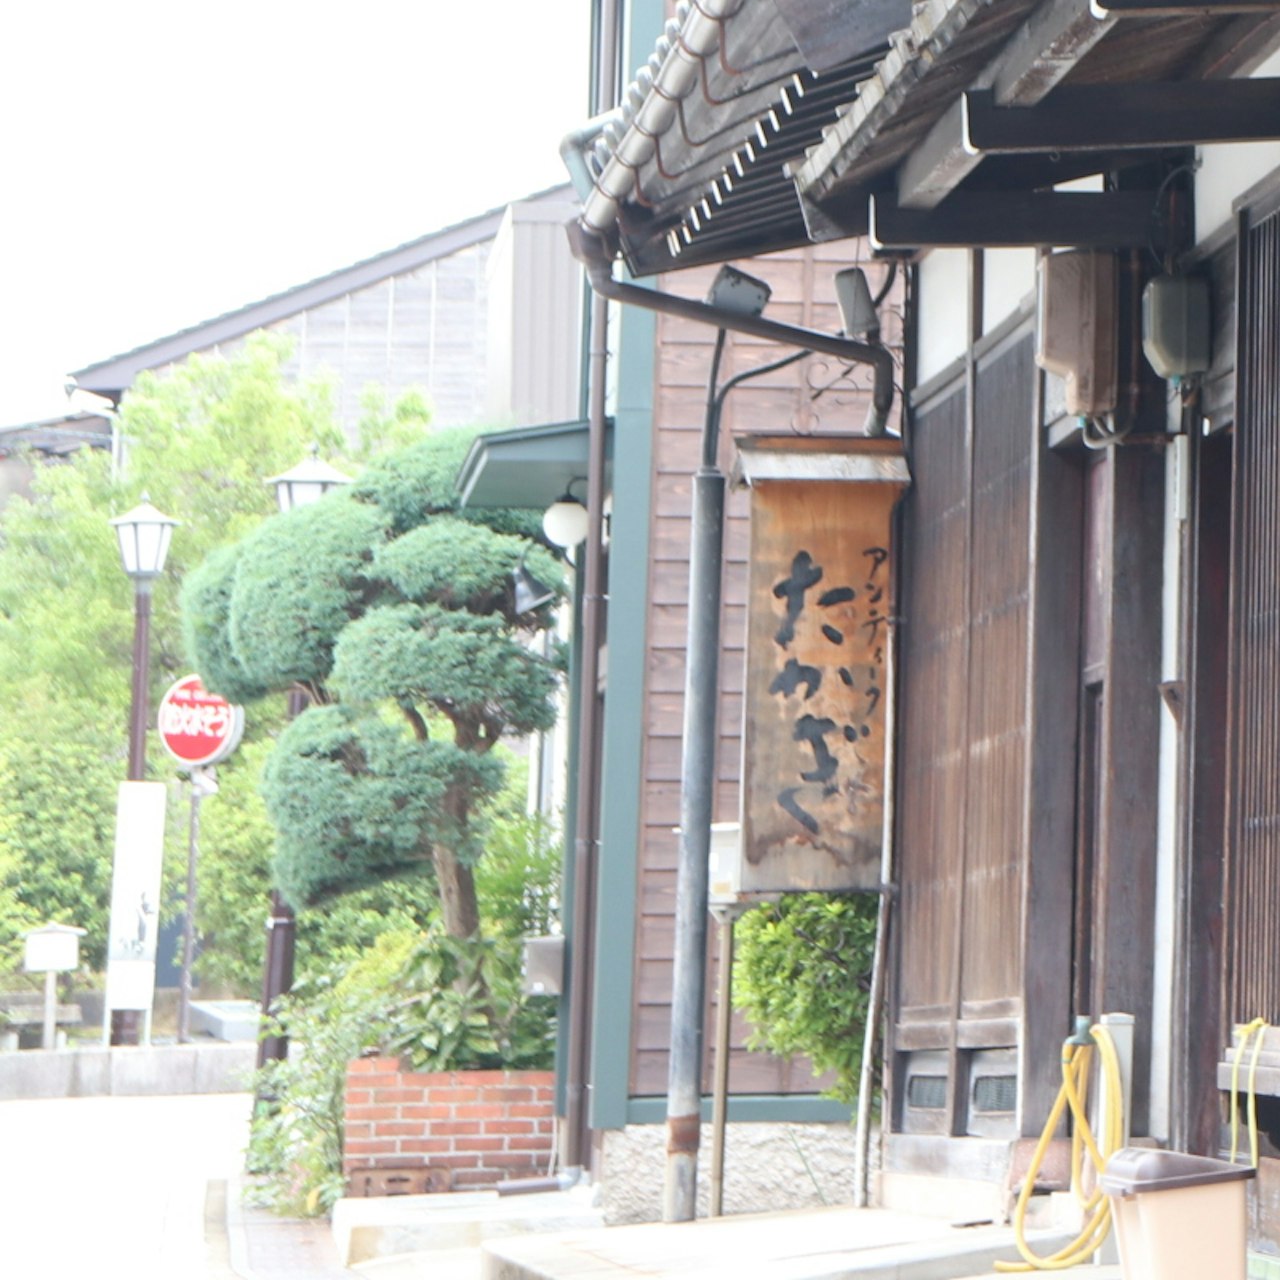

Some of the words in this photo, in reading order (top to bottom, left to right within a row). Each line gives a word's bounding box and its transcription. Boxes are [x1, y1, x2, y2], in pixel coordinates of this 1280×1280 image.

[861, 546, 888, 717] アンティーク
